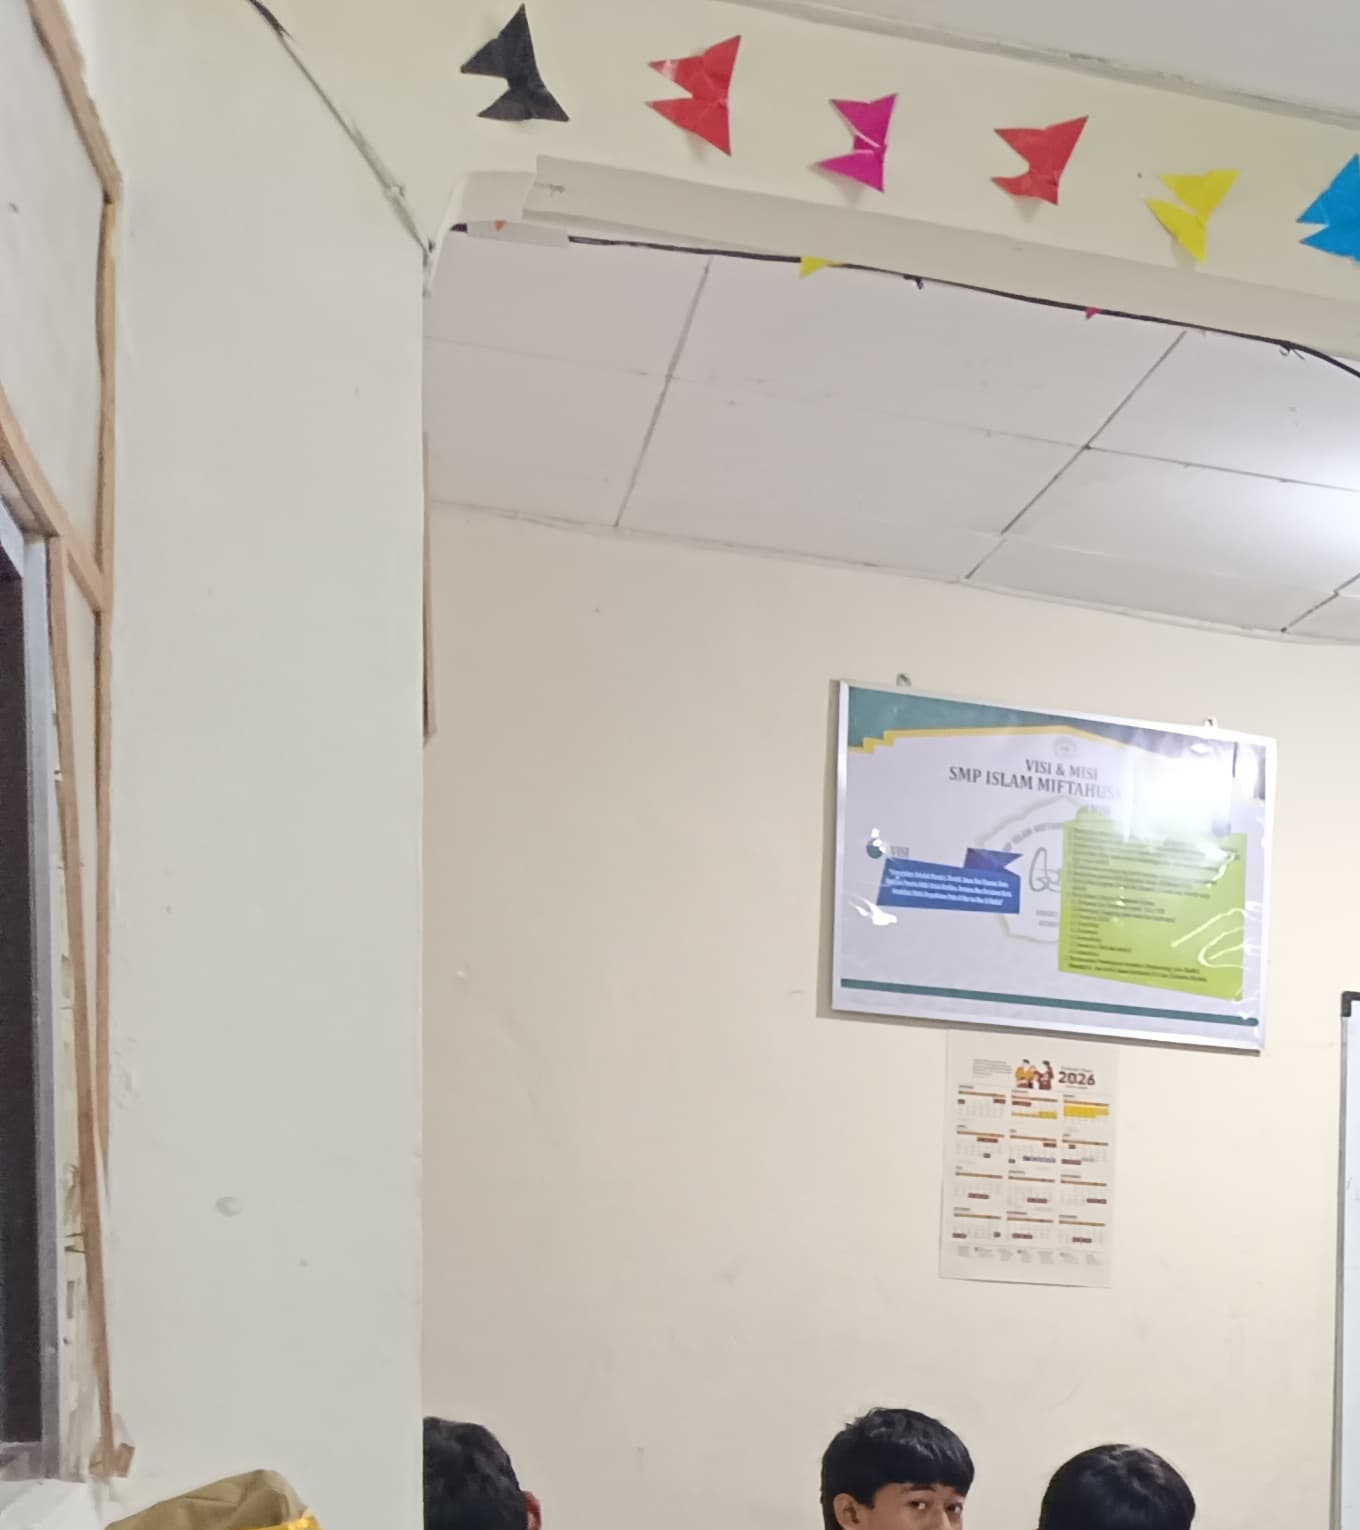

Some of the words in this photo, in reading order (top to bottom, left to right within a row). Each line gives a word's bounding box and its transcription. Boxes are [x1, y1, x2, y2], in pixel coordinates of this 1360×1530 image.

[1025, 758, 1052, 775] VISI
[1055, 763, 1065, 776] &
[948, 766, 982, 784] SMP
[985, 771, 1033, 790] ISLAM
[1058, 1070, 1096, 1087] 2026
